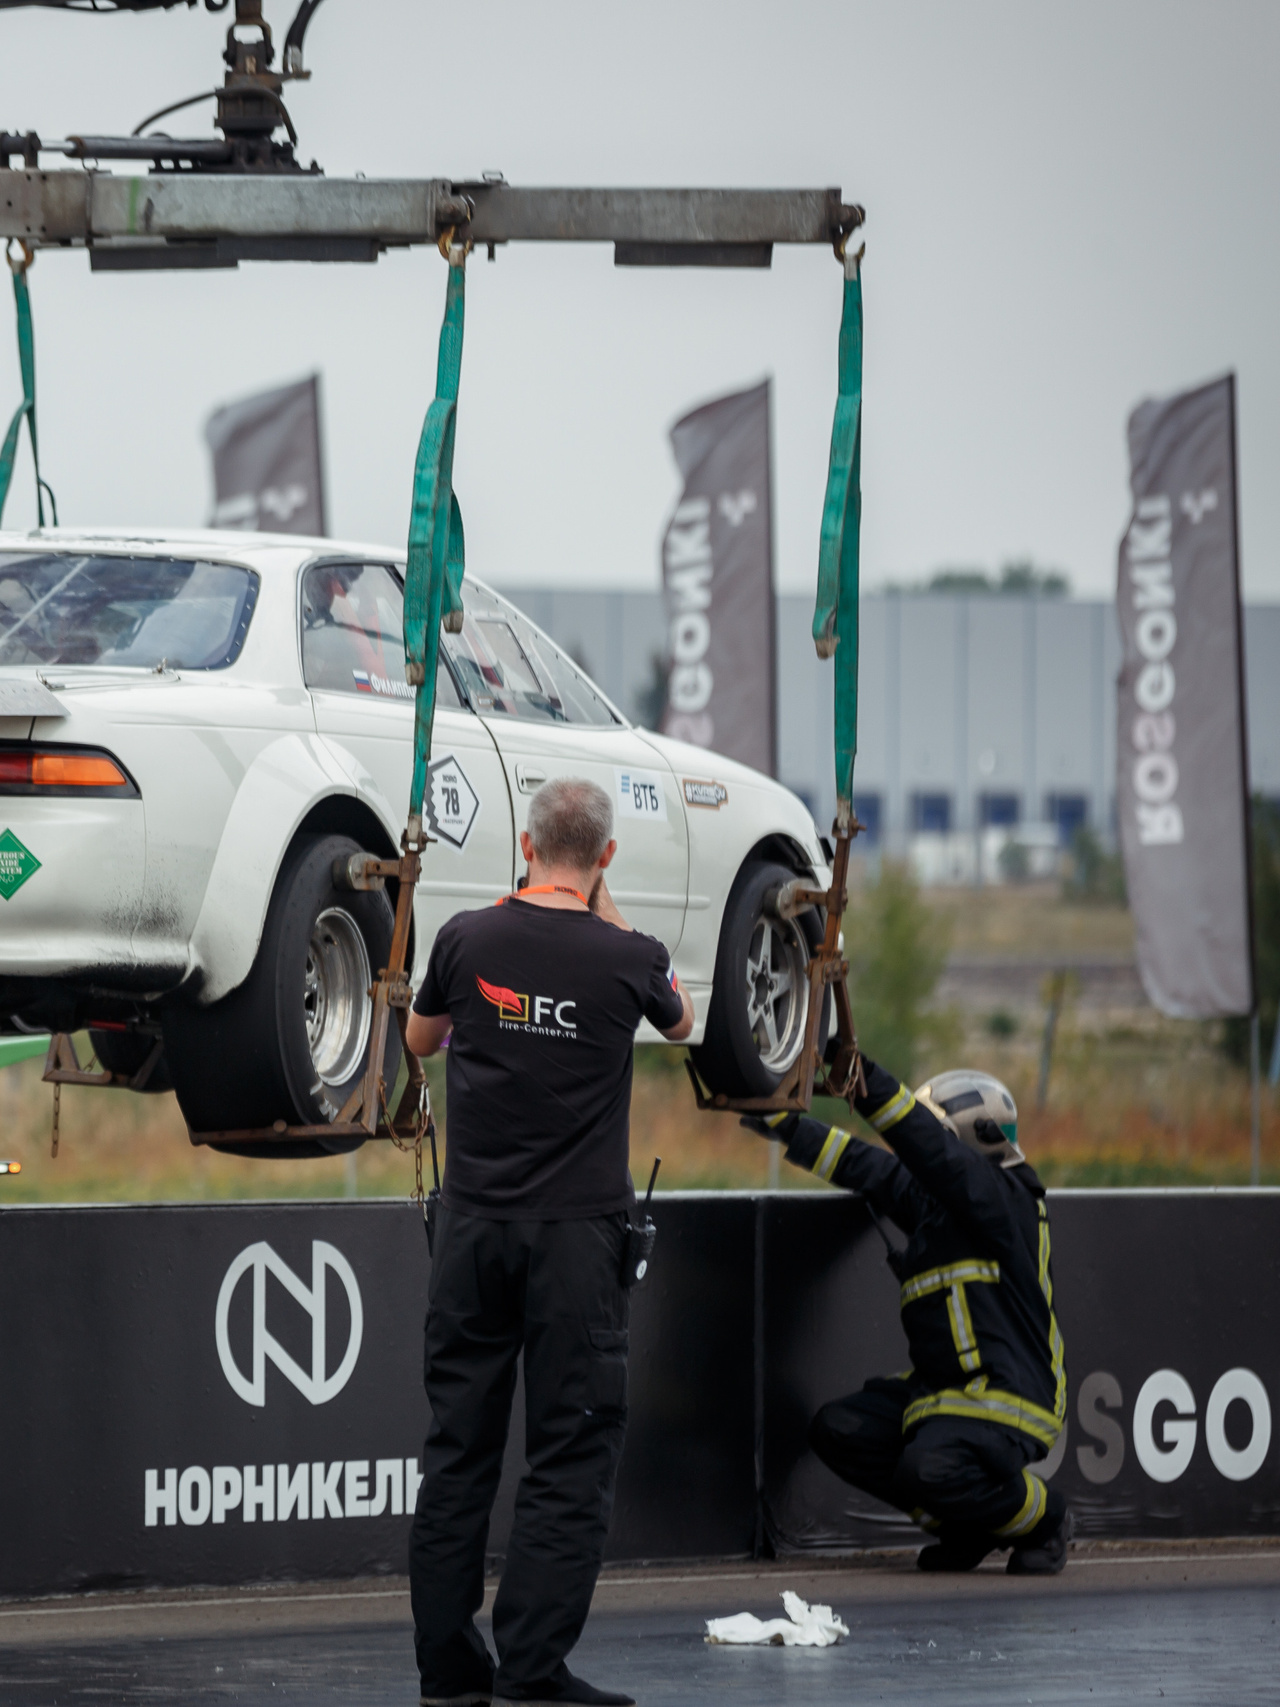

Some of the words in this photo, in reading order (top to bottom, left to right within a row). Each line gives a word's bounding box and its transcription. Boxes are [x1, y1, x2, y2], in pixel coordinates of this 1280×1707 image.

[441, 787, 460, 815] 78
[633, 783, 658, 811] ВТБ
[534, 995, 577, 1029] FC
[499, 1020, 577, 1039] Fire-Center.ru
[1023, 1366, 1272, 1484] SGO
